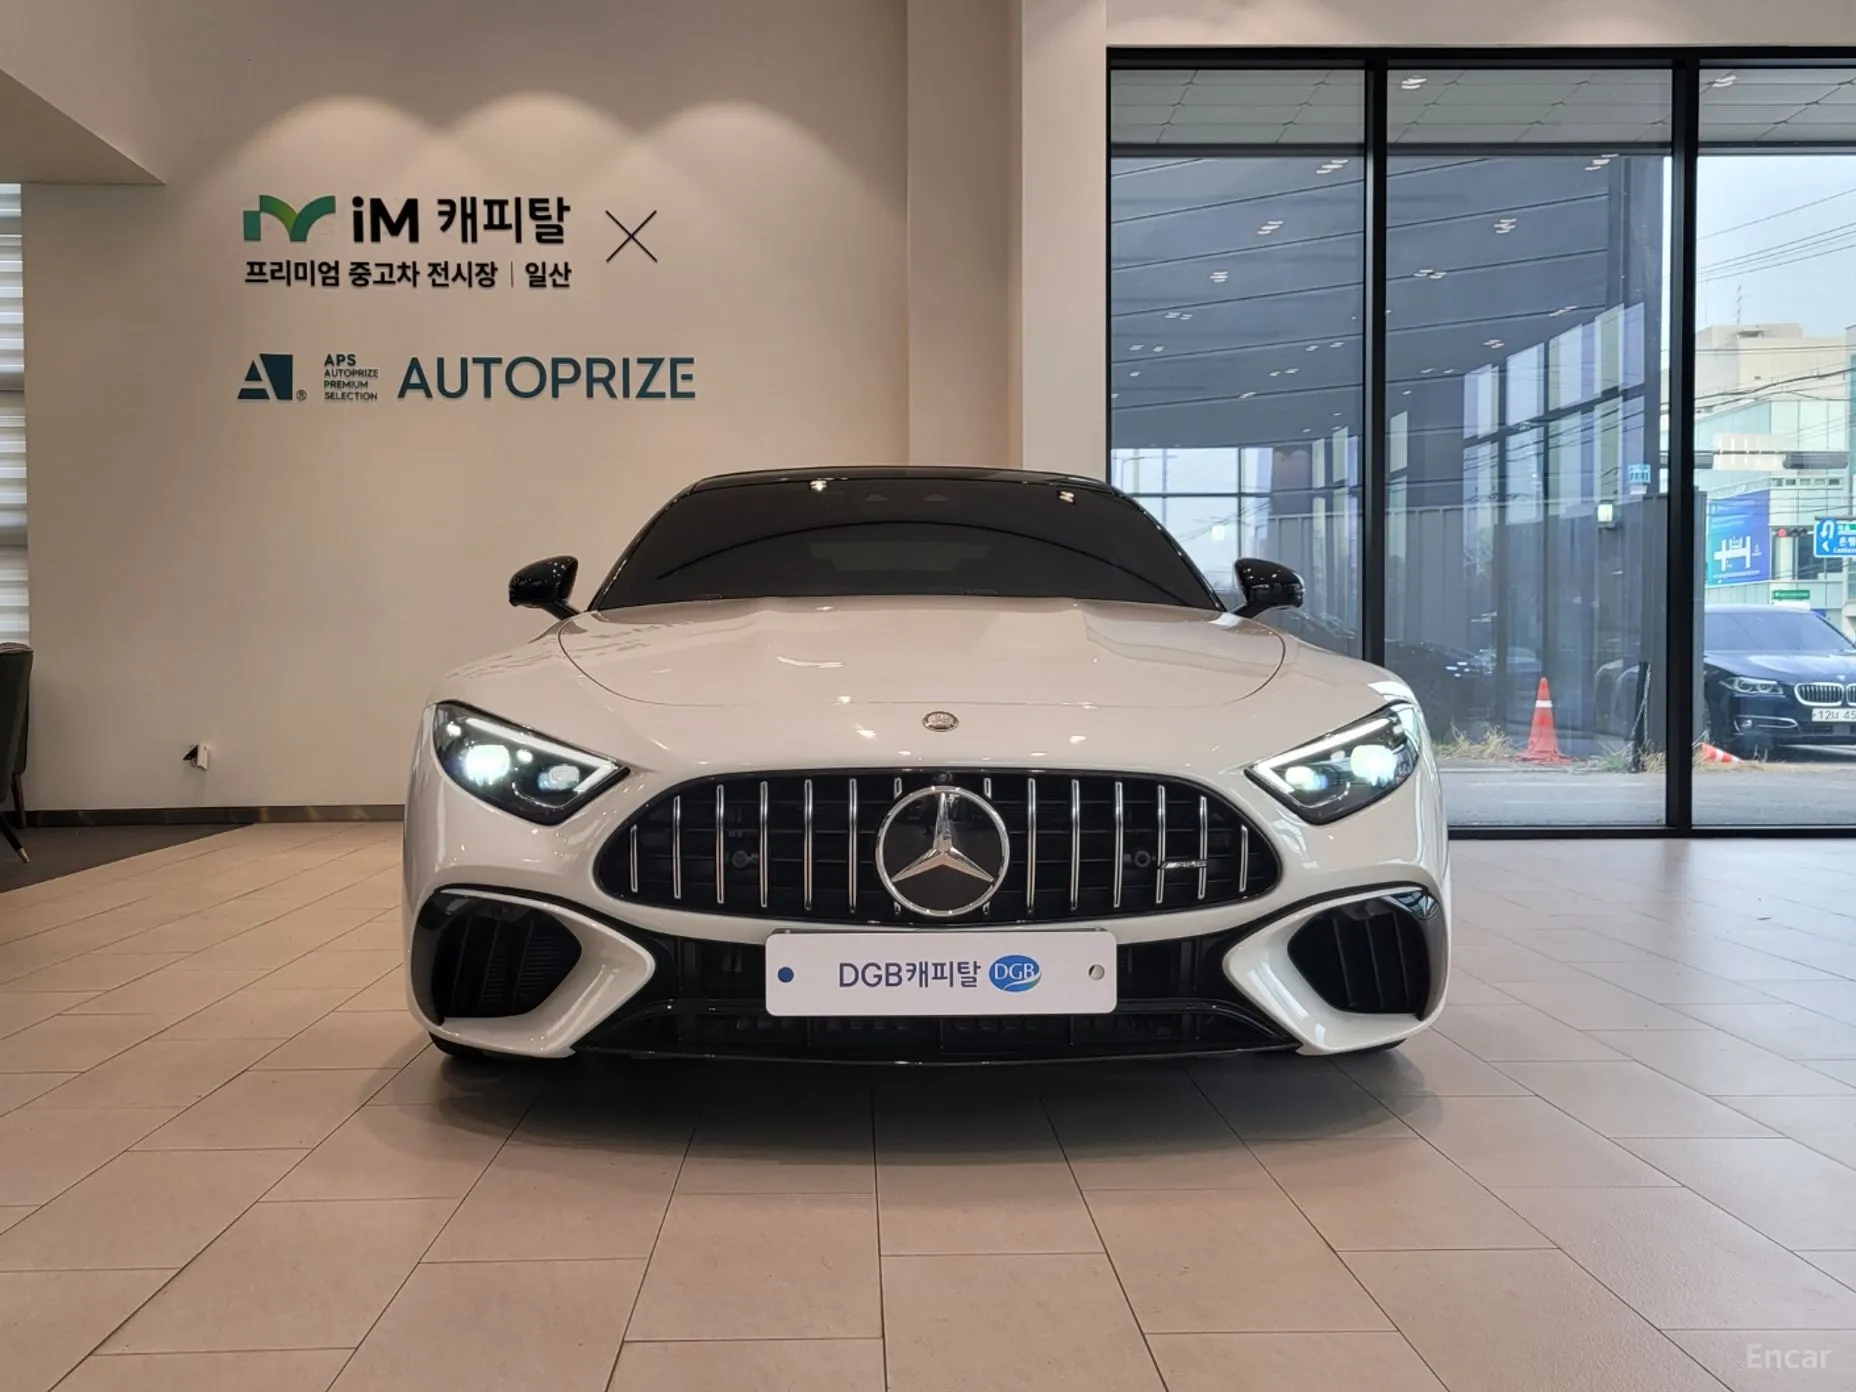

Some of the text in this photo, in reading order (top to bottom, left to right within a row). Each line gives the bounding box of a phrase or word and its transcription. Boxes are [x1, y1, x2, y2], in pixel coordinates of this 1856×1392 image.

[352, 196, 420, 243] iM
[437, 196, 571, 245] 캐피탈
[245, 260, 572, 288] 프리미엄 중고차 전시장 일산
[324, 353, 356, 367] APS
[324, 368, 379, 378] AUTOPRIZE
[398, 356, 696, 399] AUTOPRIZE
[324, 380, 369, 389] PREMIUM
[324, 391, 378, 401] SELECTION
[838, 961, 1035, 988] DGB캐피탈 DGB
